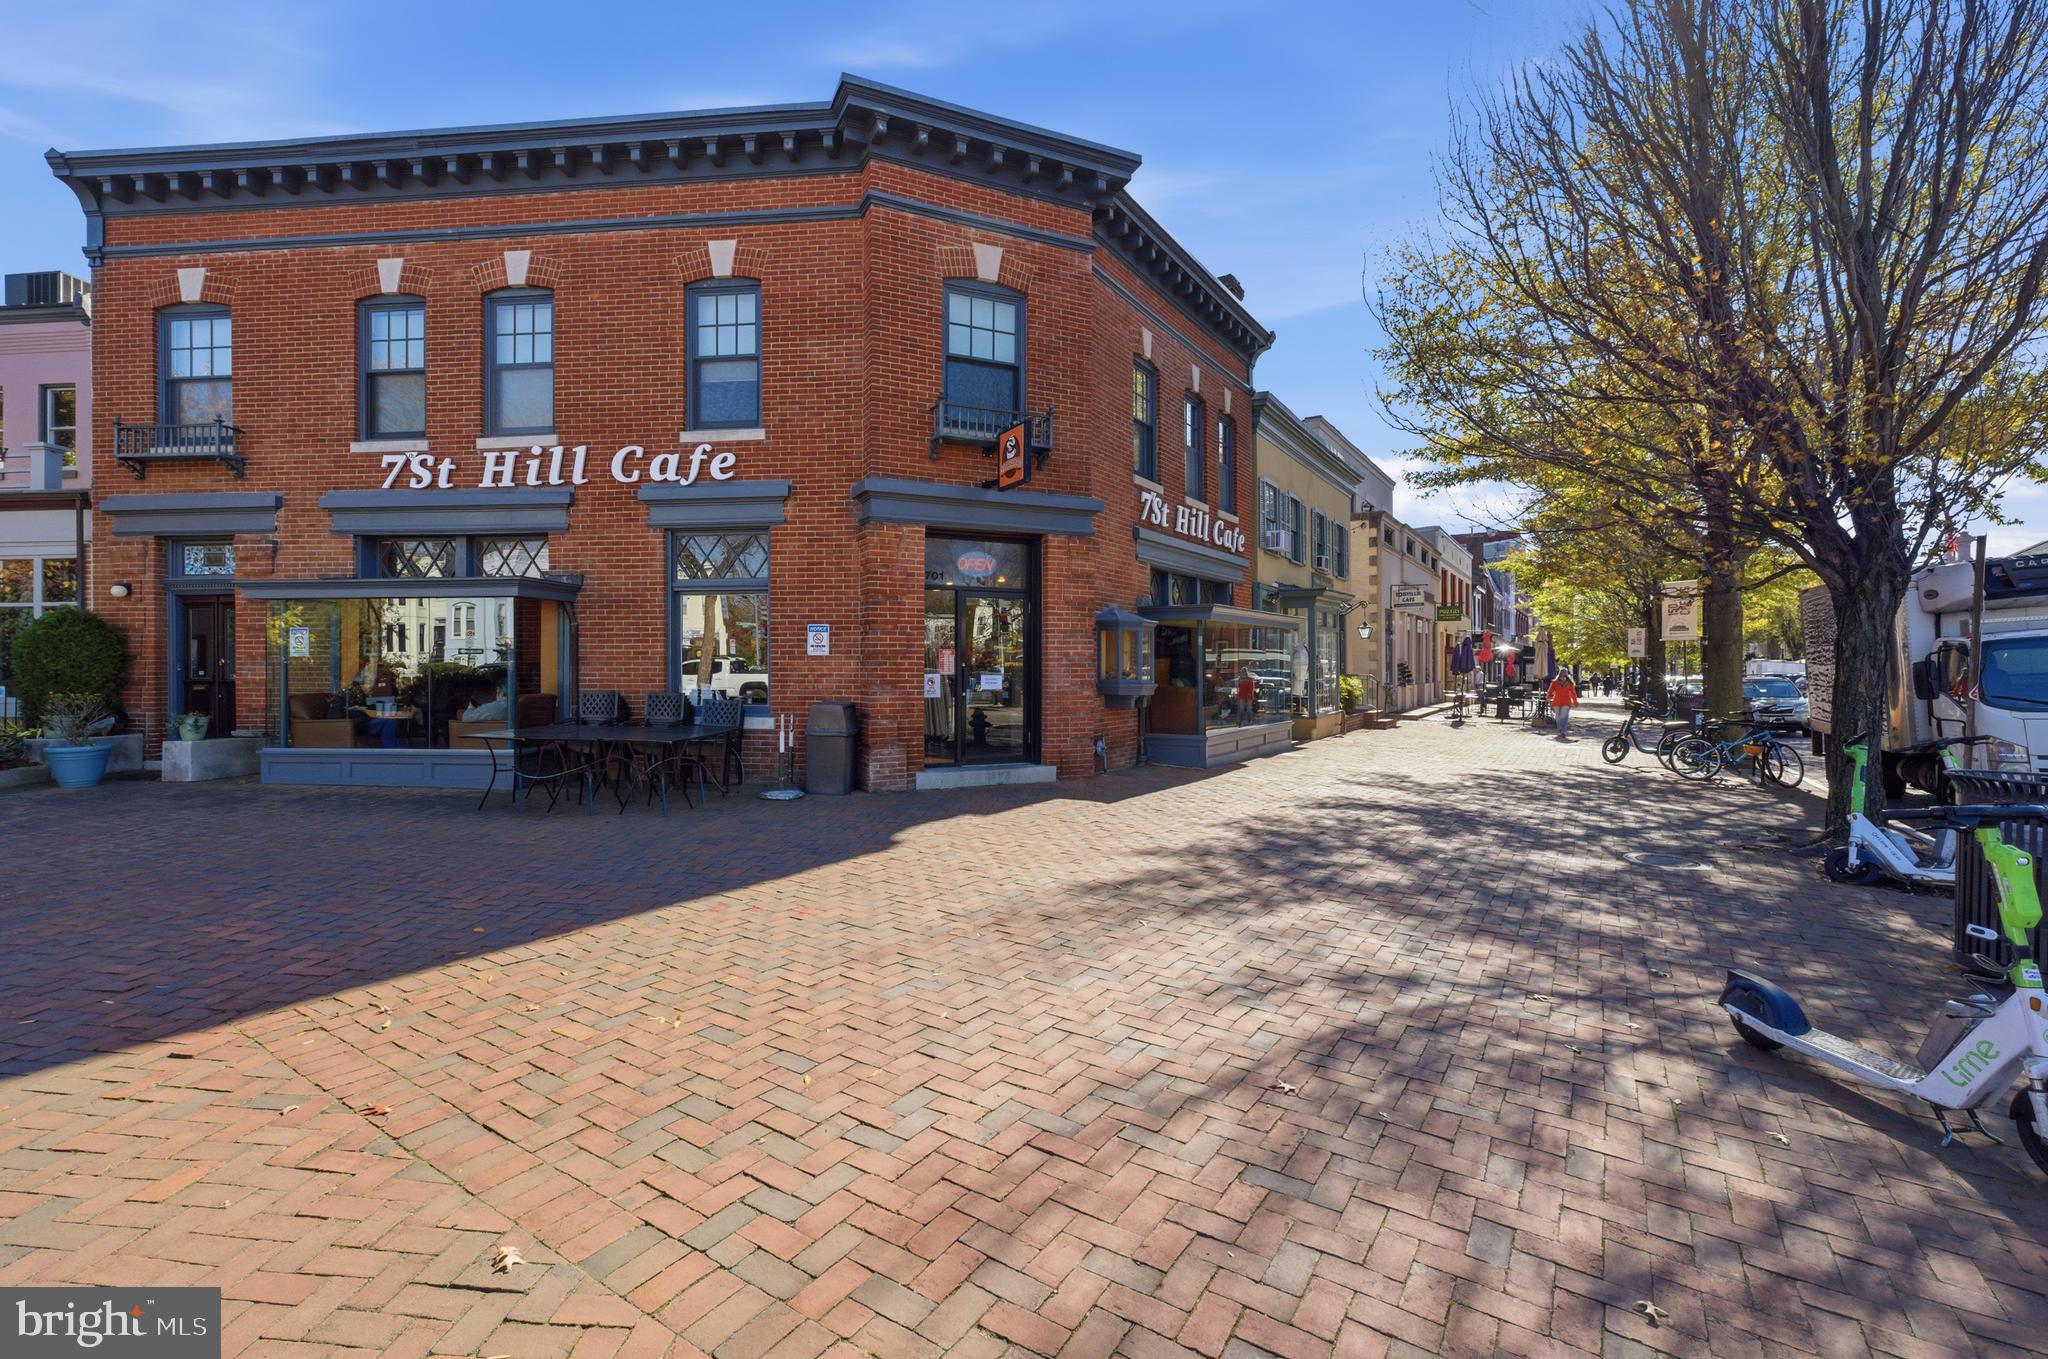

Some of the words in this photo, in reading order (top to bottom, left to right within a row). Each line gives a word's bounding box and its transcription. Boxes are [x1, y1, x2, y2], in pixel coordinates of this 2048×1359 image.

[478, 445, 590, 488] Hill
[611, 443, 737, 487] Cafe
[1175, 505, 1210, 542] Hill
[1213, 520, 1245, 552] Cafe
[924, 570, 944, 581] 701
[957, 557, 996, 571] OPEN
